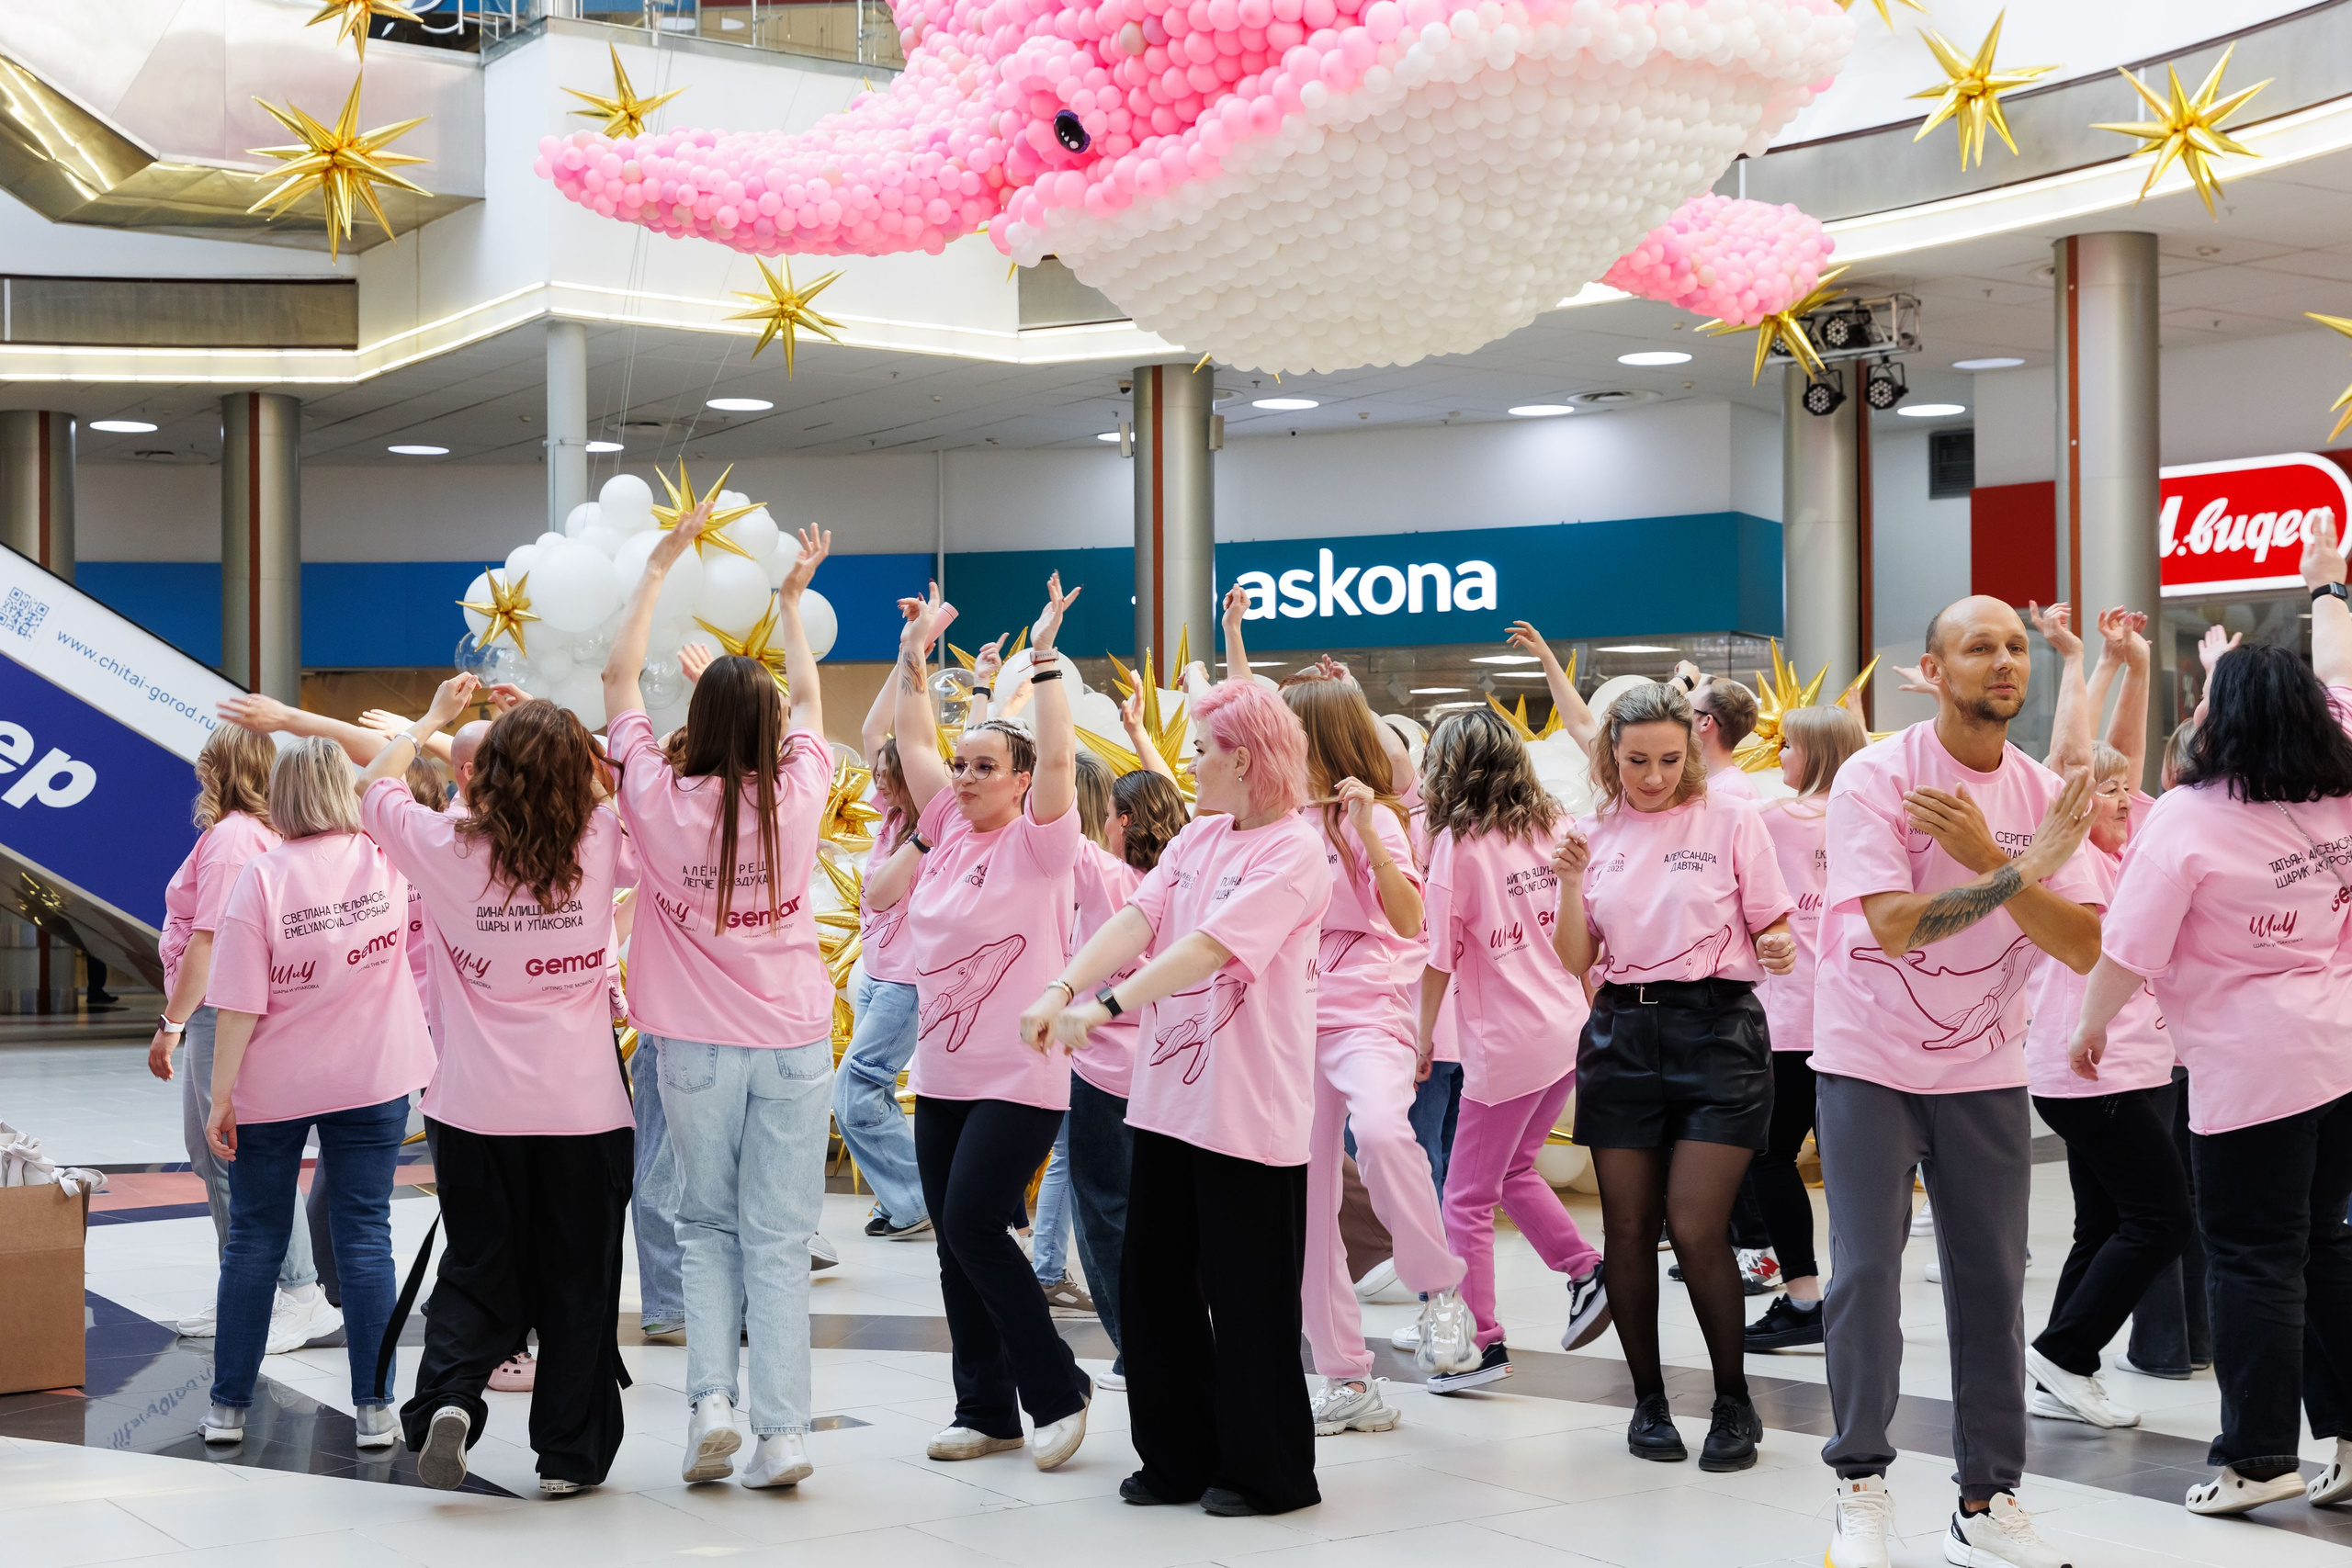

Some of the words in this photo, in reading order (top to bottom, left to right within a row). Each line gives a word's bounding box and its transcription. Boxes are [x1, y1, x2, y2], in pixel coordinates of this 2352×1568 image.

[1237, 547, 1498, 621] askona
[57, 630, 217, 731] www.chitai-gorod.ru
[1664, 850, 1717, 864] АЛЕКСАНДРА
[683, 864, 718, 876] АЛЁН
[1670, 862, 1703, 873] ДАВТЯН
[683, 876, 715, 889] ЛЕГЧЕ
[2275, 865, 2311, 889] ШАРИК
[282, 905, 332, 926] СВЕТЛАНА
[476, 906, 504, 918] ДИНА
[476, 919, 510, 932] ШАРЫ
[514, 920, 523, 932] И
[527, 916, 583, 931] УПАКОВКА
[525, 947, 606, 977] Gemar
